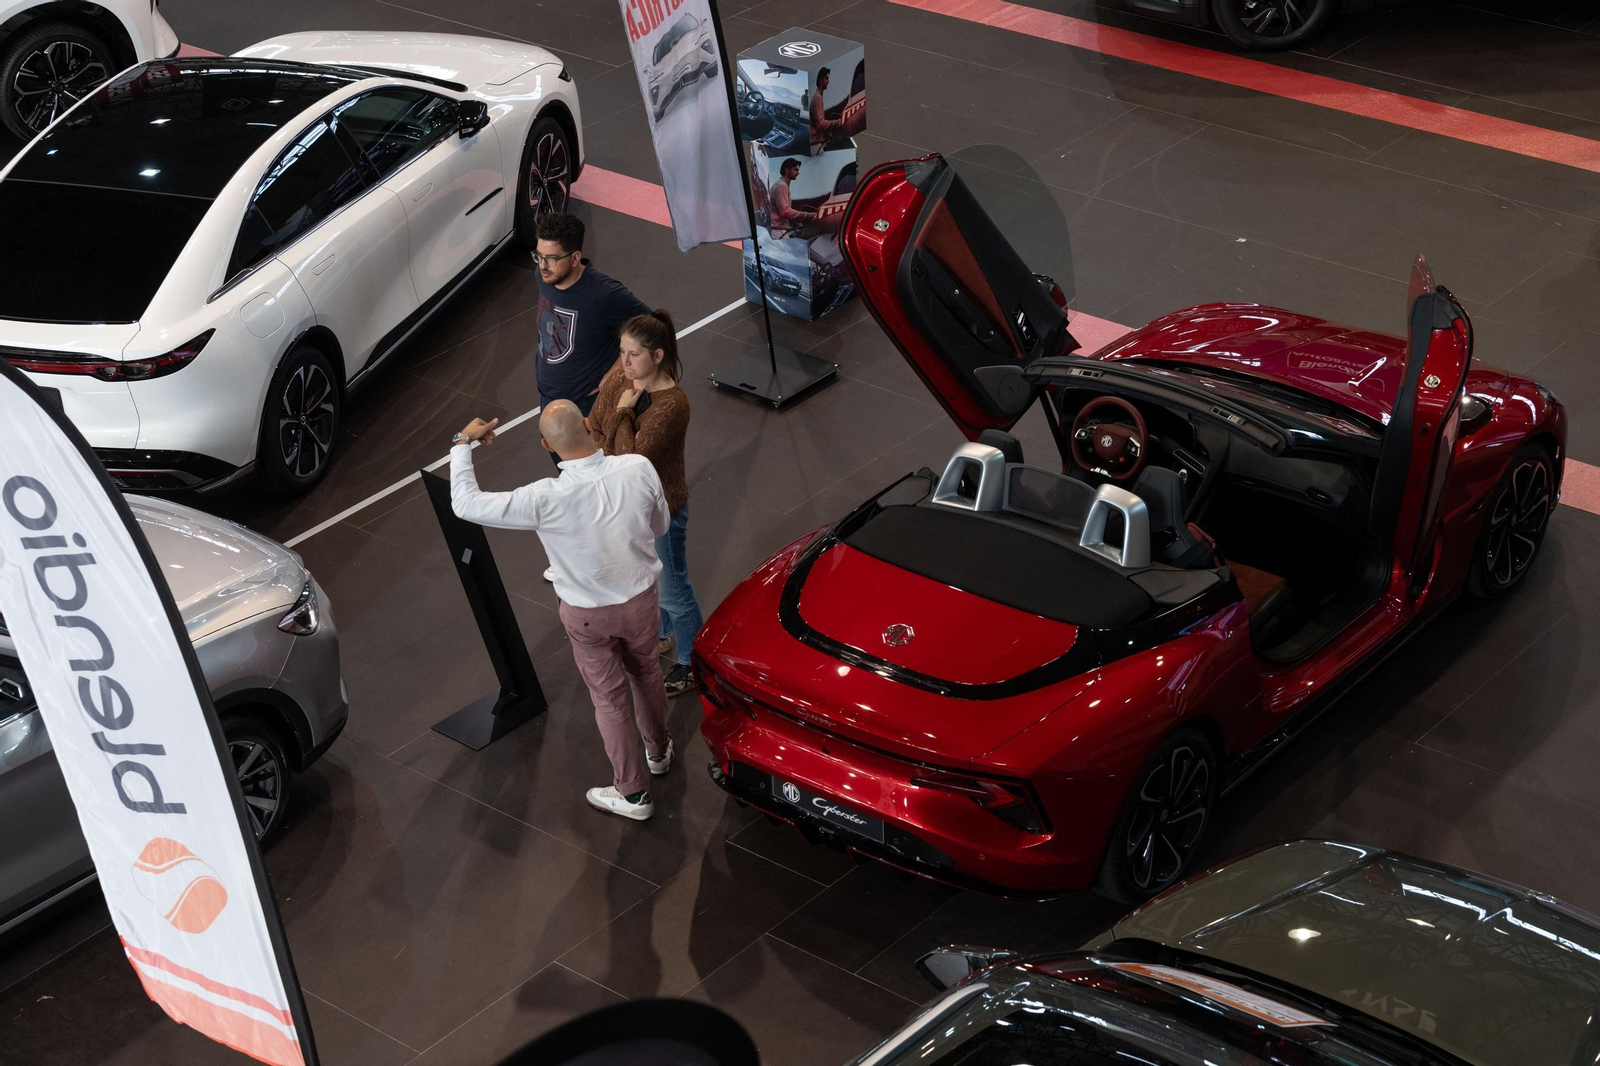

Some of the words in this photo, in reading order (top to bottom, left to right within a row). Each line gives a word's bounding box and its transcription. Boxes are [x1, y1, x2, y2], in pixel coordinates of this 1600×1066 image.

[780, 42, 819, 57] MG
[883, 624, 914, 646] MG
[783, 782, 800, 803] MG
[812, 797, 867, 825] Cyberster
